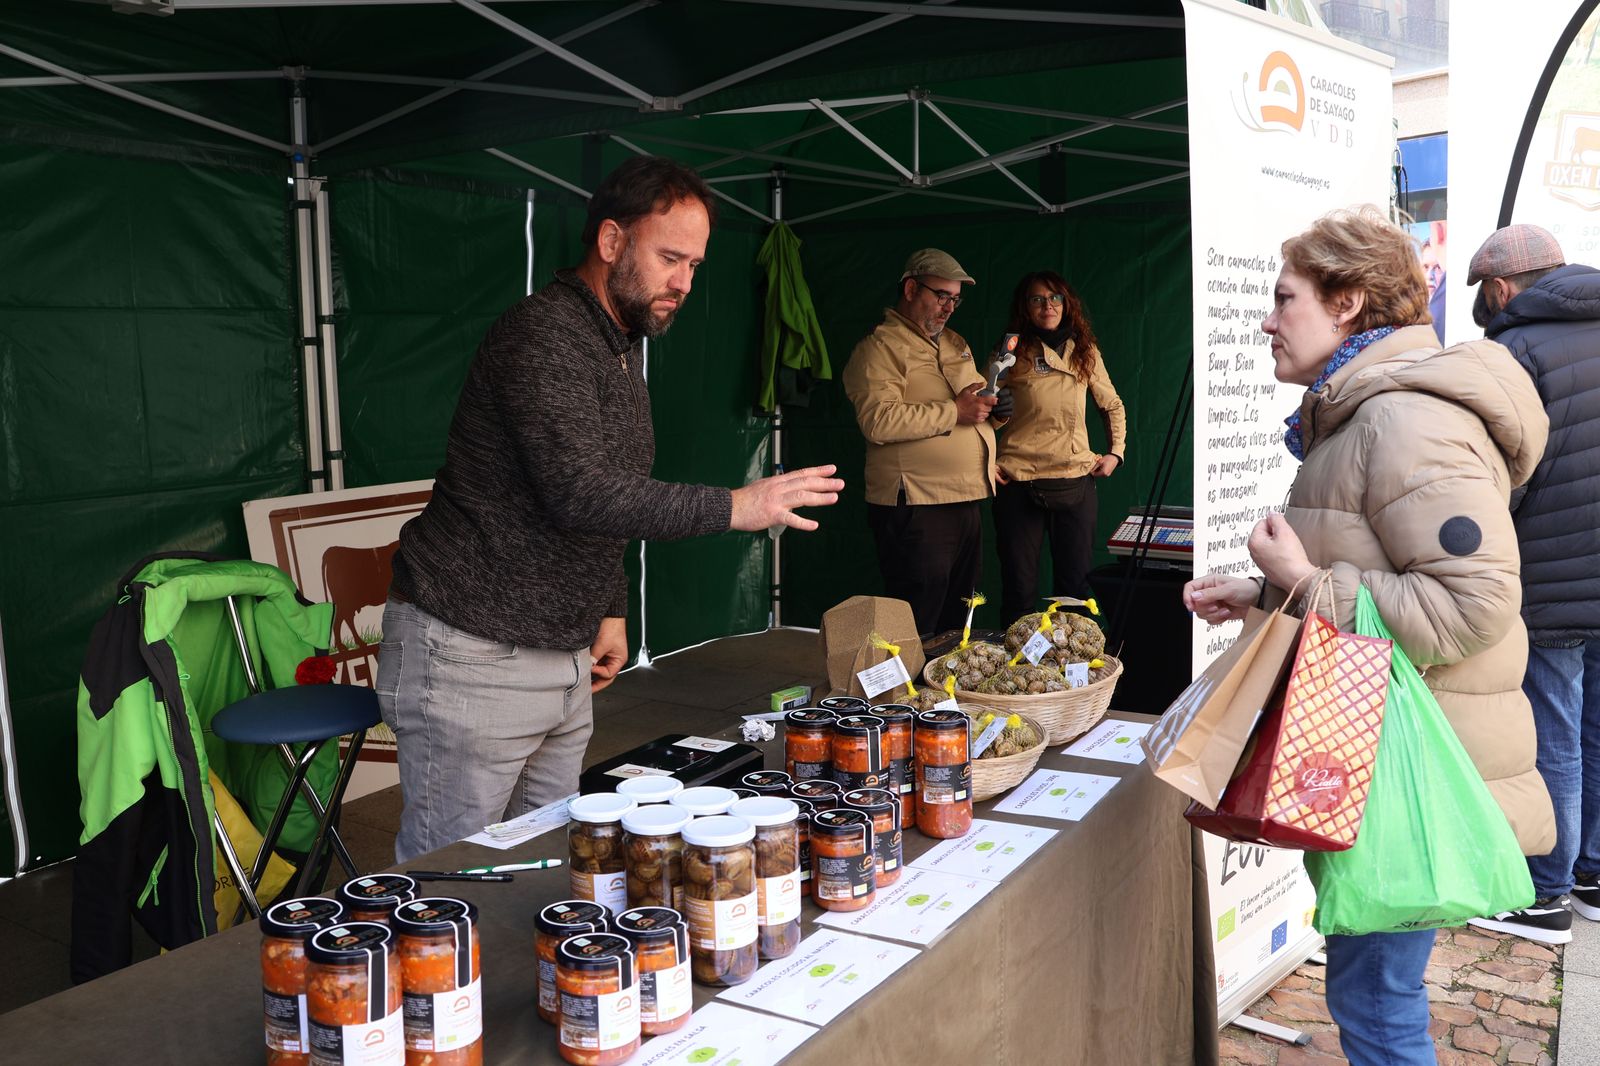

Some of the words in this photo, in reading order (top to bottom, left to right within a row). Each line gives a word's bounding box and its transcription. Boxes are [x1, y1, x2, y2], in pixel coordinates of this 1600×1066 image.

[1310, 75, 1356, 101] CARACOLES
[1310, 97, 1321, 112] DE
[1323, 100, 1355, 122] SAYAGO
[1550, 165, 1592, 187] OXEN
[1207, 247, 1224, 267] Son
[1227, 256, 1265, 273] caracoles
[1267, 259, 1276, 273] de
[1207, 277, 1237, 295] concha
[1241, 278, 1259, 295] dura
[1261, 280, 1269, 296] de
[1207, 301, 1240, 321] nuestra
[1208, 327, 1236, 347] situada
[1240, 333, 1250, 345] en
[1208, 352, 1231, 376] Buey.
[1235, 353, 1254, 371] Bien
[1208, 379, 1250, 399] bordeados
[1253, 386, 1258, 401] y
[1260, 383, 1276, 400] muy
[1243, 403, 1259, 423] Los
[1208, 431, 1247, 450] caracoles
[1249, 431, 1267, 447] vivos
[1269, 426, 1284, 446] esta
[1207, 463, 1217, 481] ya
[1220, 454, 1258, 479] purgados
[1259, 457, 1265, 475] y
[1267, 452, 1283, 471] solo
[1207, 489, 1216, 503] es
[1219, 482, 1257, 500] necesario
[1207, 504, 1255, 533] enjuagarlos
[1207, 540, 1226, 560] para
